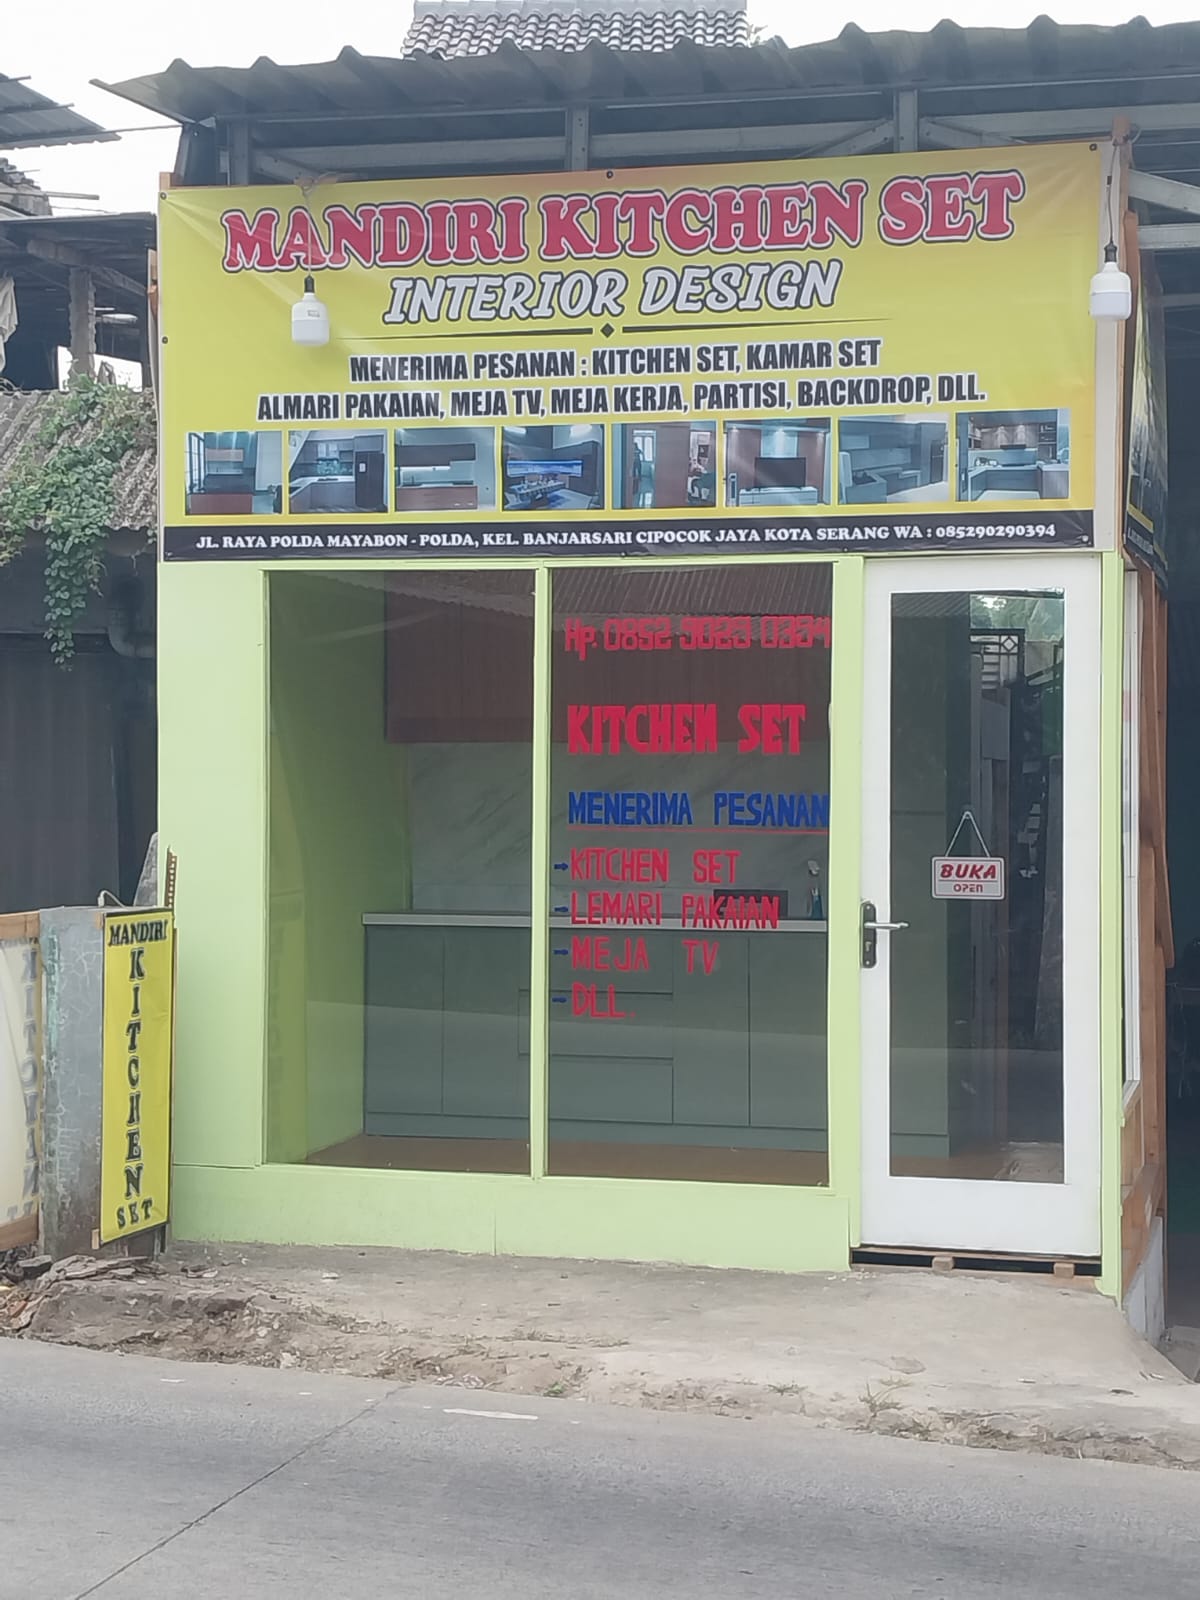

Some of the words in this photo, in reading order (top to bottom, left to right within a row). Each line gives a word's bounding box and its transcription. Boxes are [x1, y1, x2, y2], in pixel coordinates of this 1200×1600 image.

[222, 196, 529, 273] MANDIRI
[539, 179, 868, 260] KITCHEN
[879, 169, 1026, 245] SET
[383, 269, 628, 325] INTERIOR
[638, 258, 843, 316] DESIGN
[350, 354, 469, 382] MENERIMA
[473, 350, 576, 379] PESANAN
[592, 346, 691, 376] KITCHEN
[696, 345, 741, 374] SET,
[746, 342, 833, 371] KAMAR
[838, 340, 882, 367] SET
[257, 393, 340, 421] ALMARI
[345, 391, 446, 420] PAKAIAN,
[450, 389, 508, 417] MEJA
[512, 388, 546, 418] TV,
[551, 387, 609, 415] MEJA
[613, 385, 689, 413] KERJA,
[694, 381, 792, 411] PARTISI,
[797, 376, 932, 407] BACKDROP,
[937, 374, 986, 402] DLL.
[196, 536, 219, 549] JL.
[222, 536, 267, 548] RAYA
[270, 535, 325, 548] POLDA
[327, 534, 408, 548] MAYABON
[419, 533, 480, 548] POLDA,
[482, 532, 519, 546] KEL.
[523, 531, 632, 545] BANJARSARI
[636, 530, 711, 544] CIPOCOK
[715, 528, 761, 543] JAYA
[764, 527, 813, 542] KOTA
[816, 526, 890, 541] SERANG
[893, 526, 923, 539] WA
[935, 523, 1056, 538] 085290290394
[565, 617, 598, 661] Hp.
[604, 617, 672, 650] 0852
[567, 703, 718, 755] KITCHEN
[738, 703, 807, 755] SET
[568, 791, 693, 826] MENERIMA
[713, 792, 829, 828] PESANAN
[570, 847, 669, 883] KITCHEN
[693, 850, 741, 885] SET
[940, 864, 997, 880] BUKA
[953, 883, 984, 894] OPEN
[571, 891, 662, 926] LEMARI
[681, 895, 780, 930] PAKAIAN
[108, 919, 168, 947] MANDIRI
[571, 936, 650, 972] MEJA
[681, 938, 720, 975] TV
[124, 947, 145, 1200] KITCHEN
[116, 1197, 153, 1230] SET
